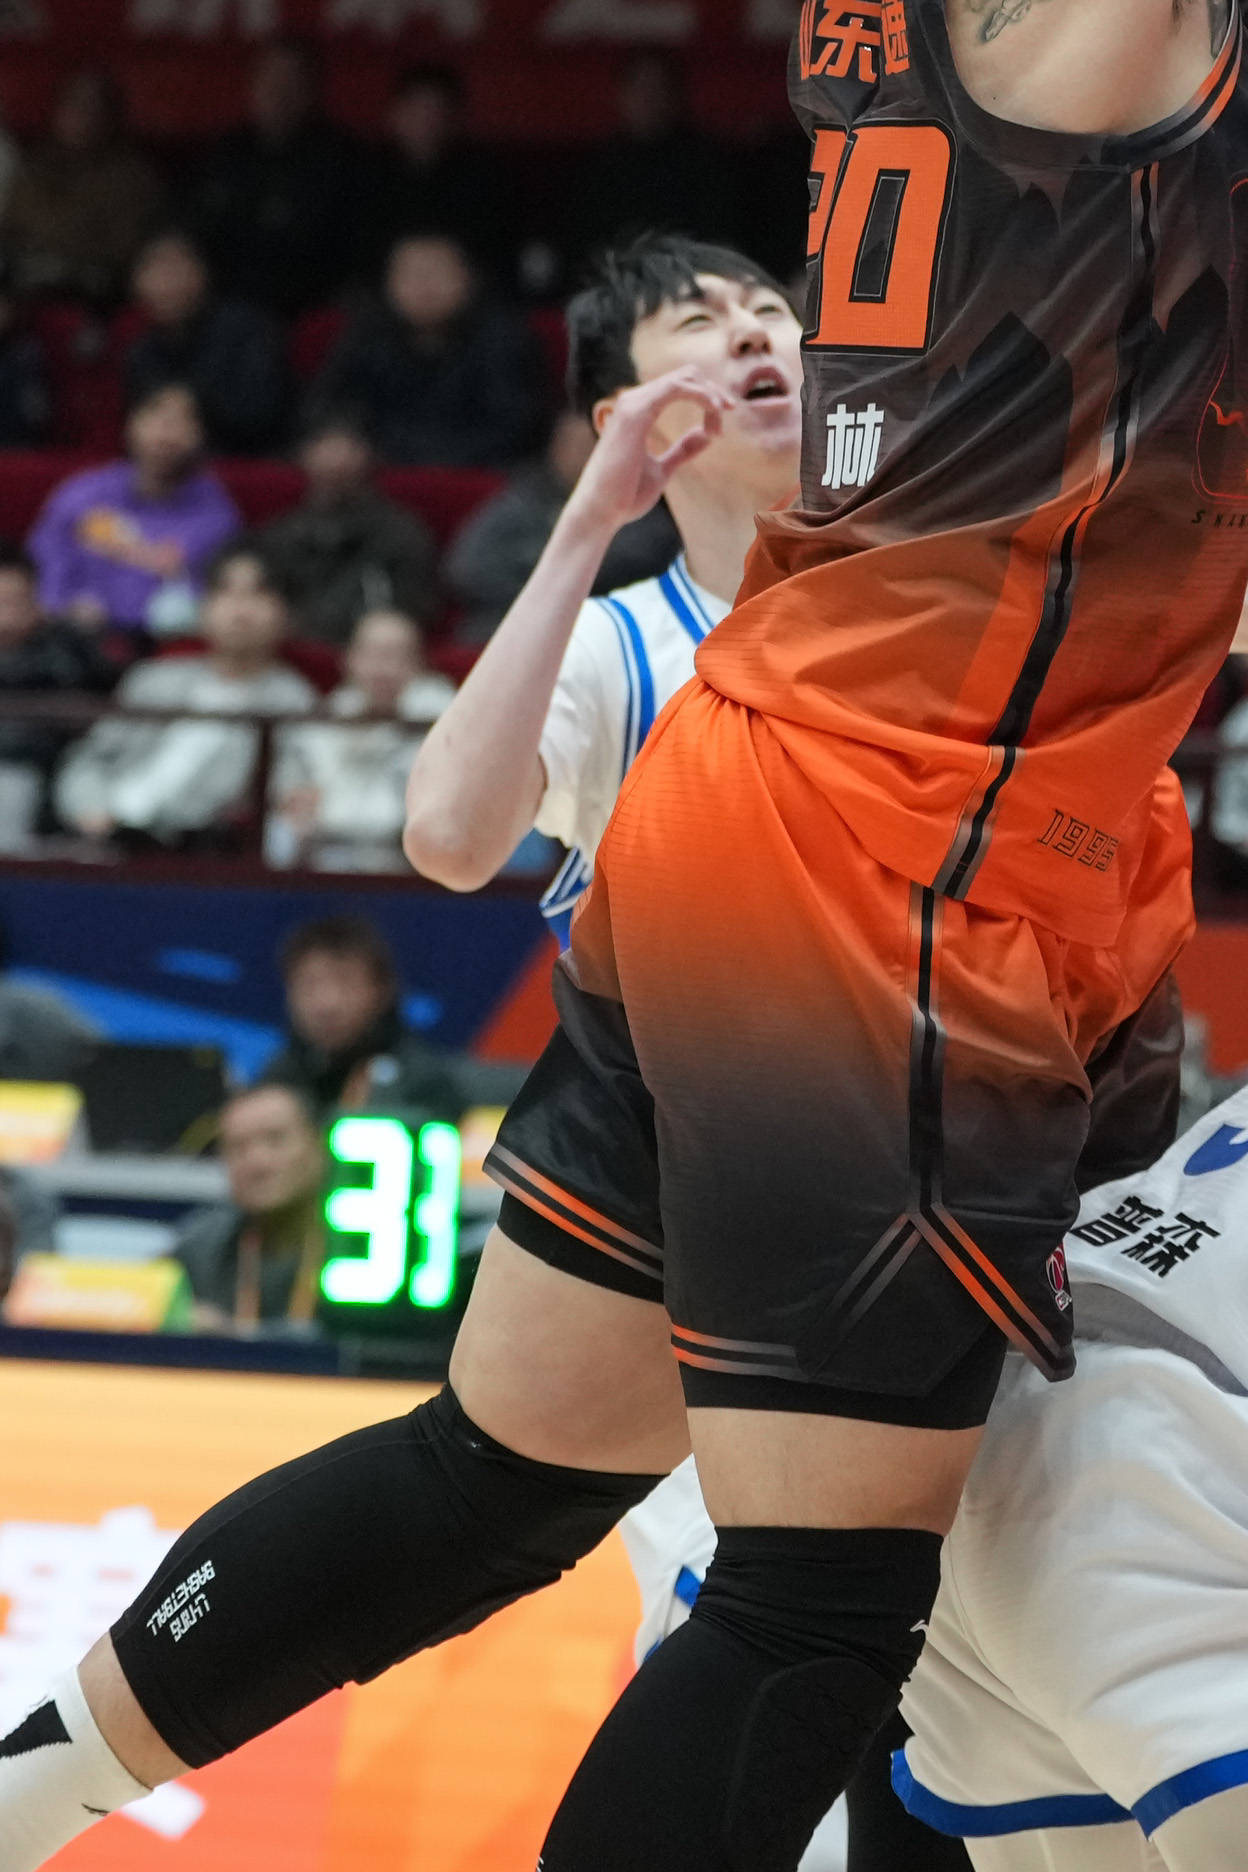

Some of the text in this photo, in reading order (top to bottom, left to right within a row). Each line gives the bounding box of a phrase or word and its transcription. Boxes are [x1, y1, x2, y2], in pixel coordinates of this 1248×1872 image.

[821, 402, 885, 490] 林
[320, 1114, 463, 1310] 31
[146, 1559, 216, 1636] BASKETBALL
